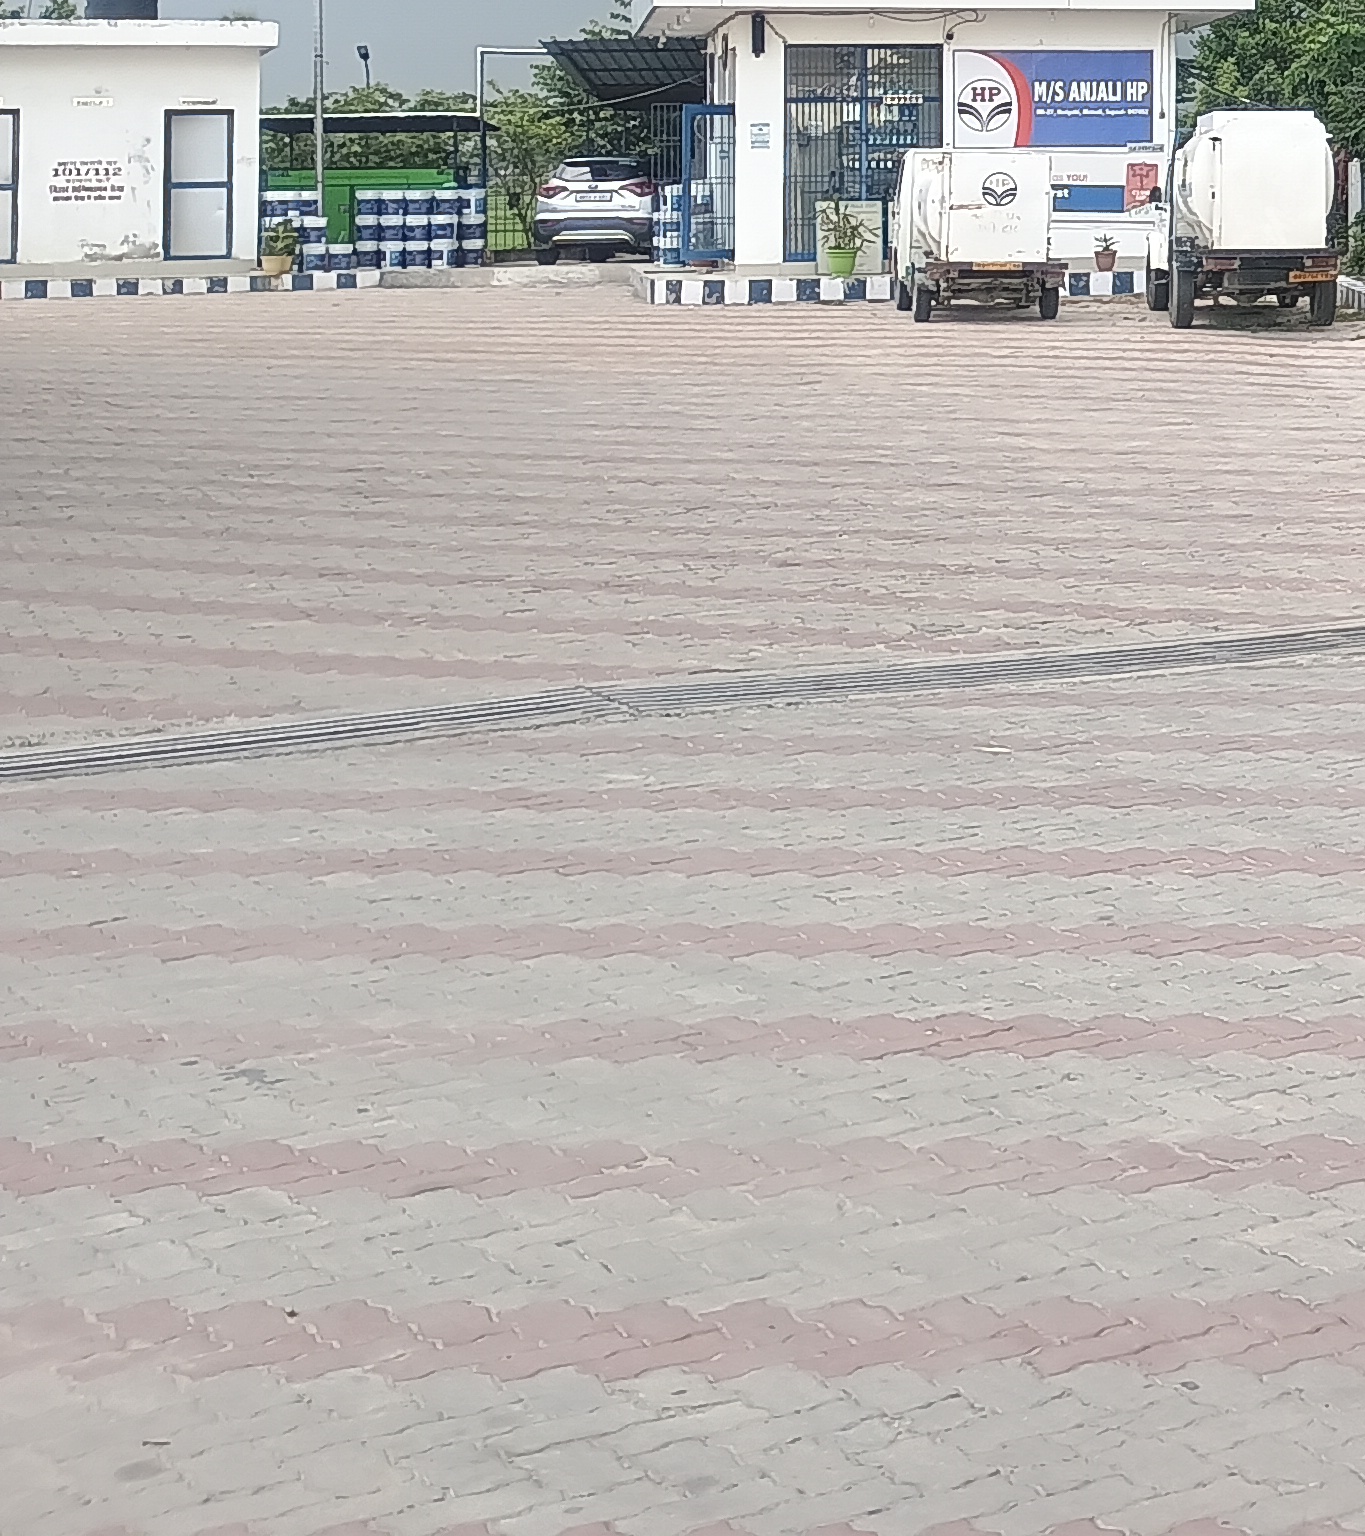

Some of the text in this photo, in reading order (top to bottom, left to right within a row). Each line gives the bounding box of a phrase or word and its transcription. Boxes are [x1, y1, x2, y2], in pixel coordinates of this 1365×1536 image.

[971, 87, 1001, 102] HP
[1034, 81, 1148, 103] M/S ANJALI HP
[52, 167, 122, 177] 101/112
